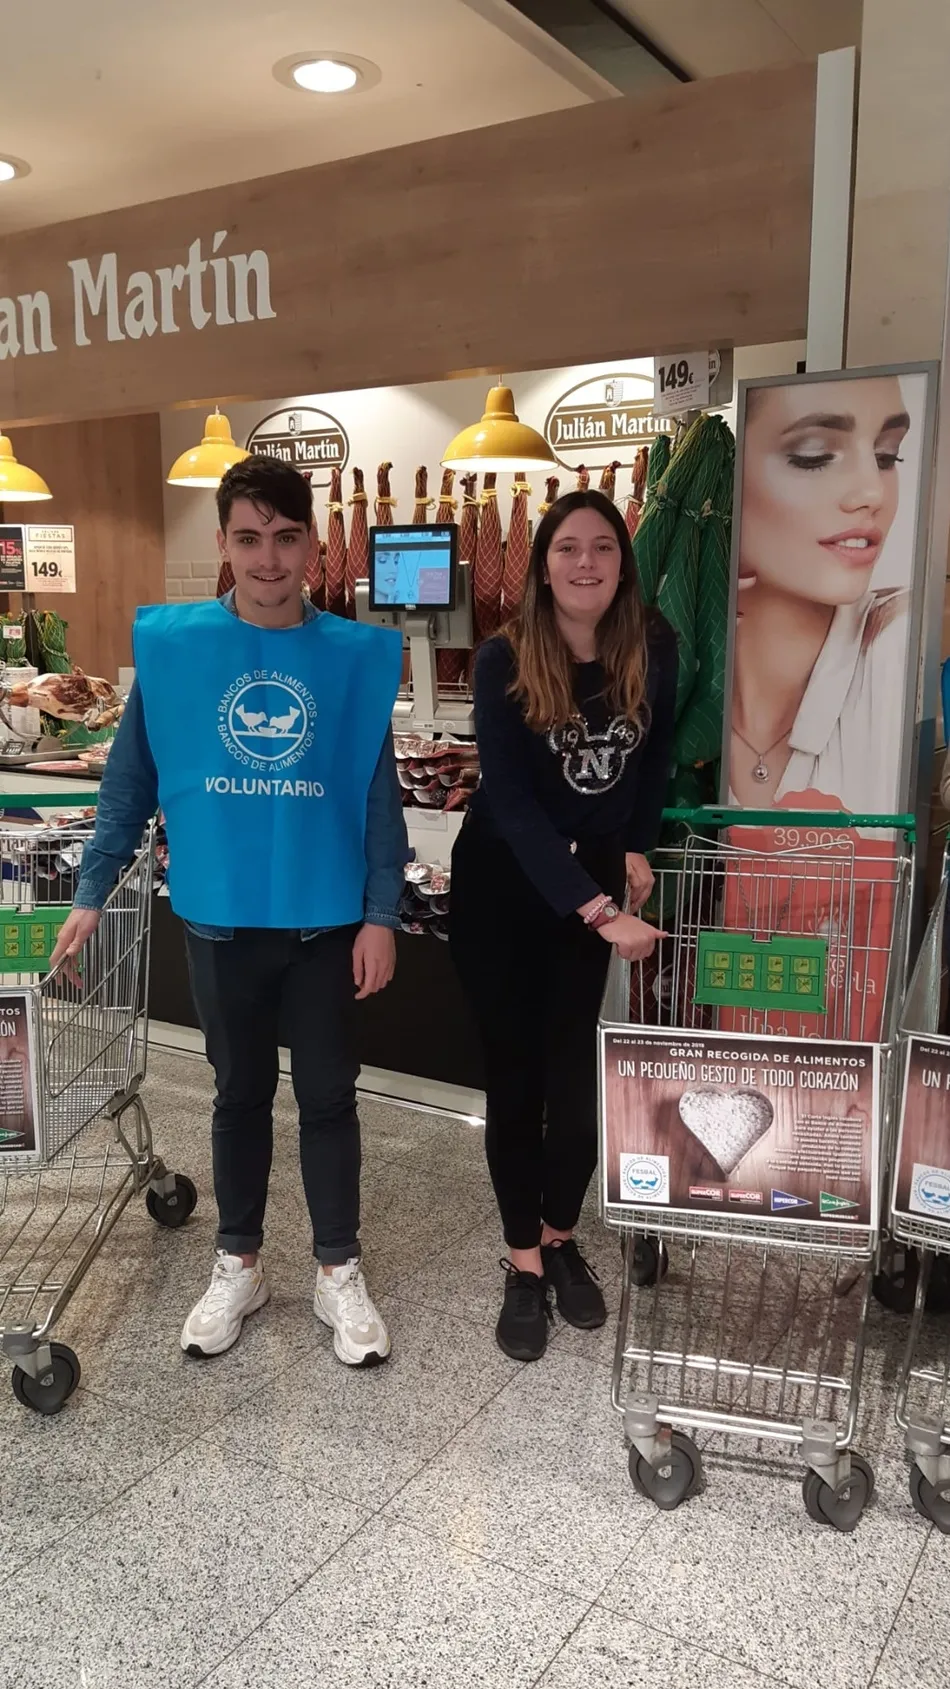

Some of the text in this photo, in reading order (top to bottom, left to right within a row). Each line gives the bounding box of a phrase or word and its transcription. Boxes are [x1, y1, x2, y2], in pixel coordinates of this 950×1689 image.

[67, 230, 277, 345] Martín
[658, 360, 694, 393] 149€
[555, 416, 606, 445] Julián
[294, 438, 340, 461] Martín
[217, 670, 318, 718] BANCOS DE ALIMENTOS
[217, 724, 315, 772] BANCOS DE ALIMENTOS
[575, 746, 616, 780] N
[205, 776, 325, 798] VOLUNTARIO
[669, 1048, 866, 1067] GRAN RECOGIDA DE ALIMENTOS
[618, 1060, 859, 1091] UN PEQUEÑO GESTO DE TODO CORAZÓN
[922, 1069, 941, 1088] UN
